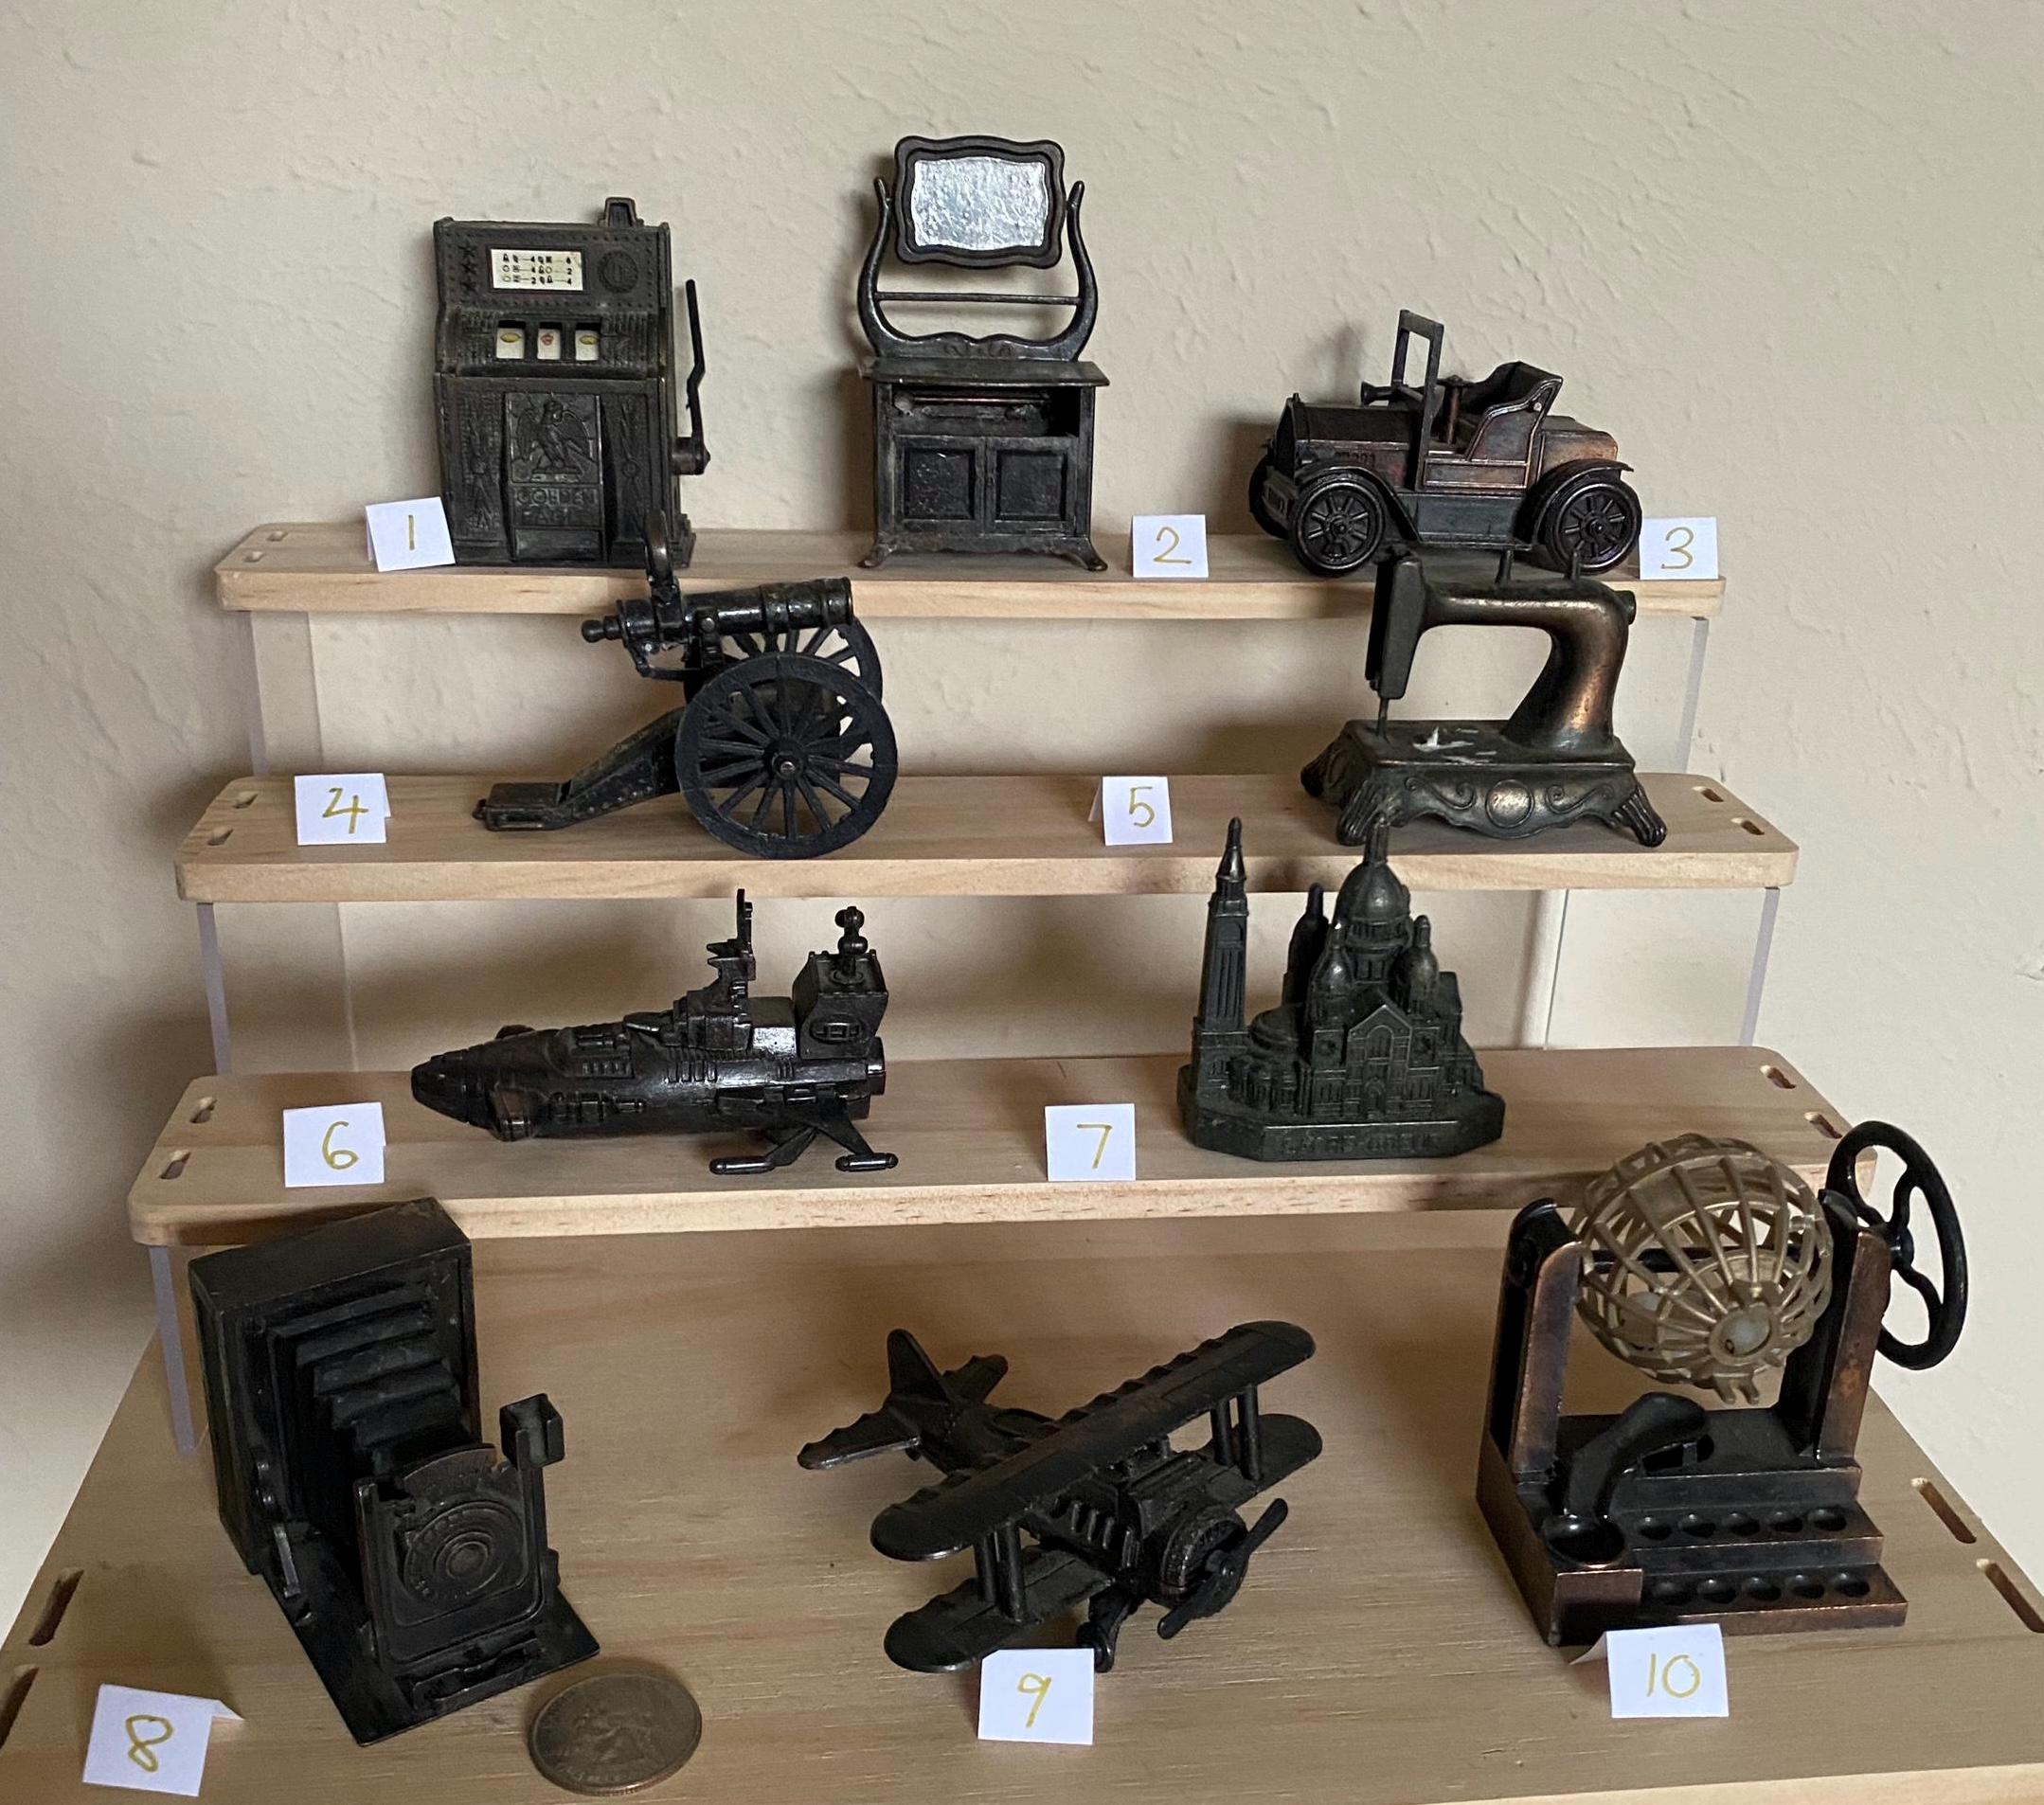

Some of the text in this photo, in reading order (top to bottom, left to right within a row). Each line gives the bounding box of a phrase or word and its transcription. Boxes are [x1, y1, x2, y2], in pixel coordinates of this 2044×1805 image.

[1152, 525, 1192, 565] 2
[1661, 526, 1695, 571] 3
[321, 784, 370, 836] 4
[1127, 783, 1156, 829] 5
[319, 1119, 361, 1171] 6
[1075, 1120, 1115, 1171] 7
[1014, 1670, 1055, 1731] 9
[1645, 1652, 1703, 1702] 10
[122, 1712, 176, 1775] 8
